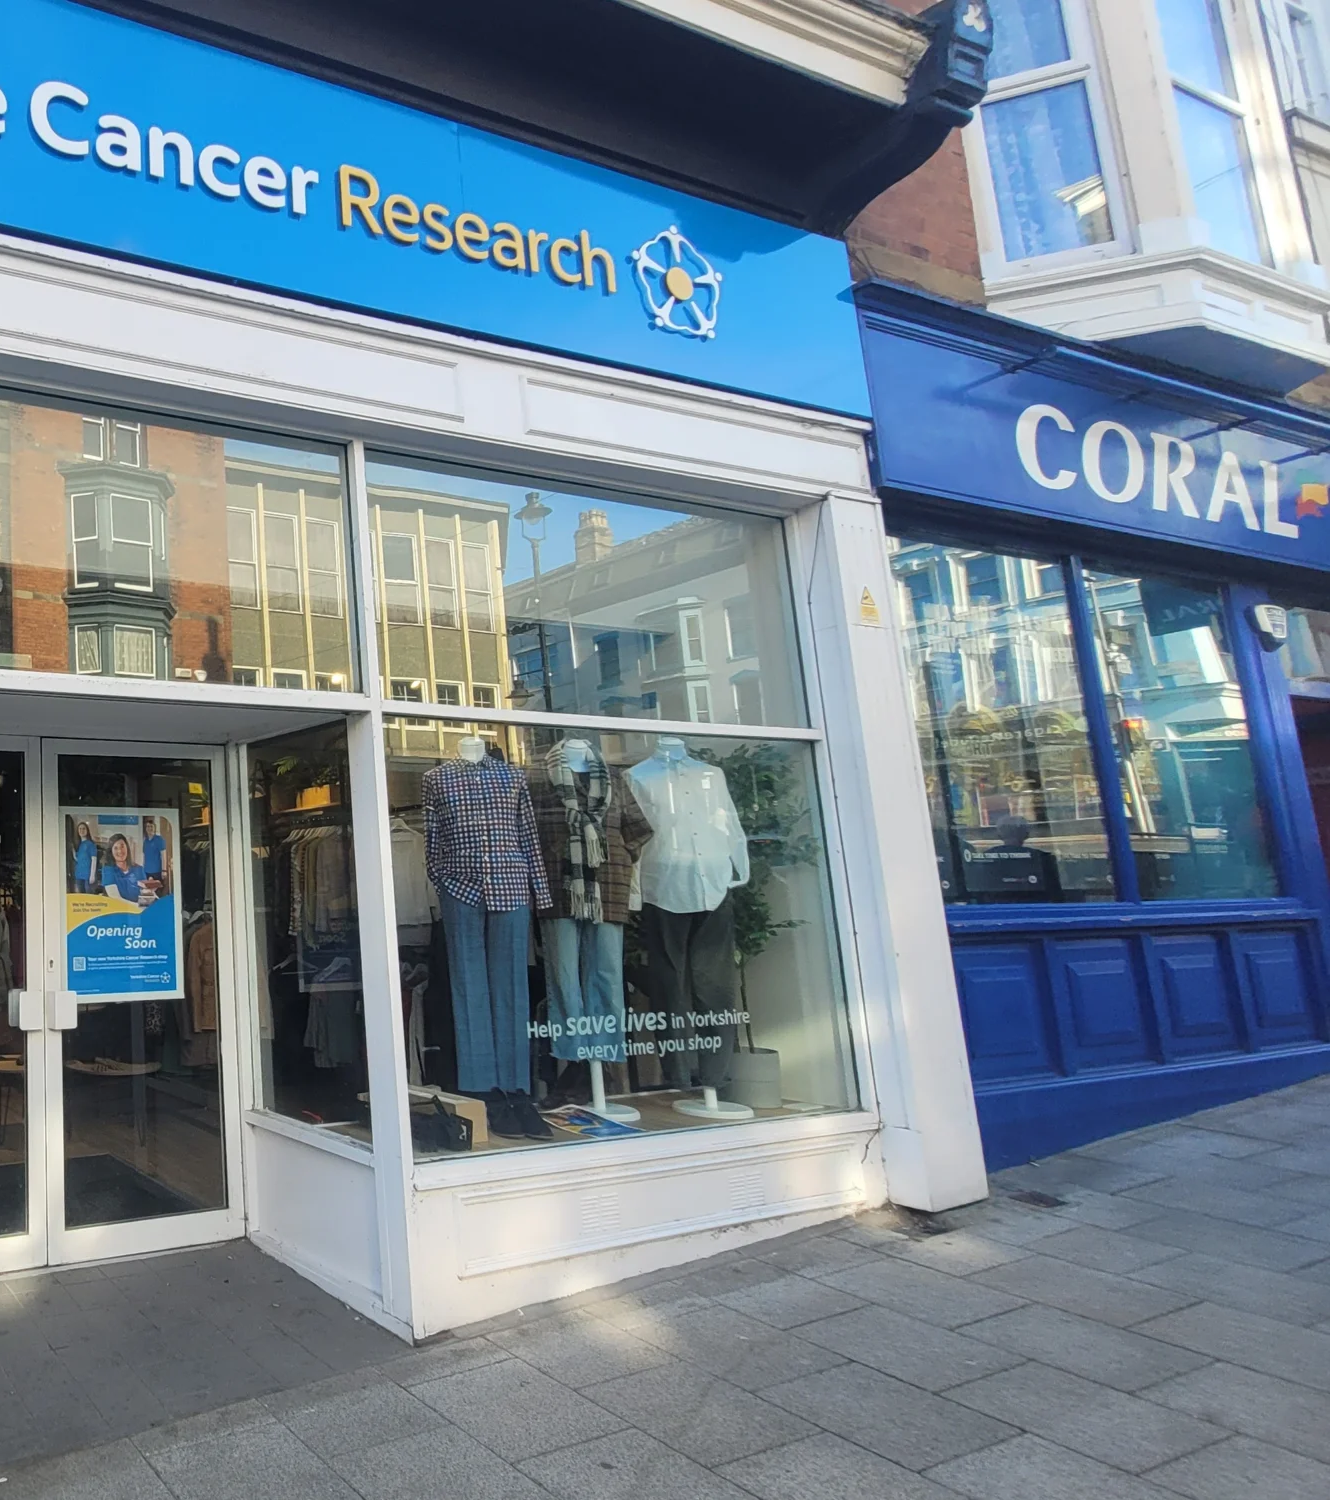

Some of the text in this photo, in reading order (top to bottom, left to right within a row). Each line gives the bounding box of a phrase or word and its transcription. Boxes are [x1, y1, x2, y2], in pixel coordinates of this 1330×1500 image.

[28, 80, 319, 215] Cancer
[337, 163, 617, 293] Research
[1015, 403, 1299, 539] CORAL
[87, 925, 142, 940] Opening
[124, 937, 157, 949] Soon
[526, 1007, 751, 1041] Help save lives in Yorkshire
[577, 1035, 722, 1060] every time you shop
